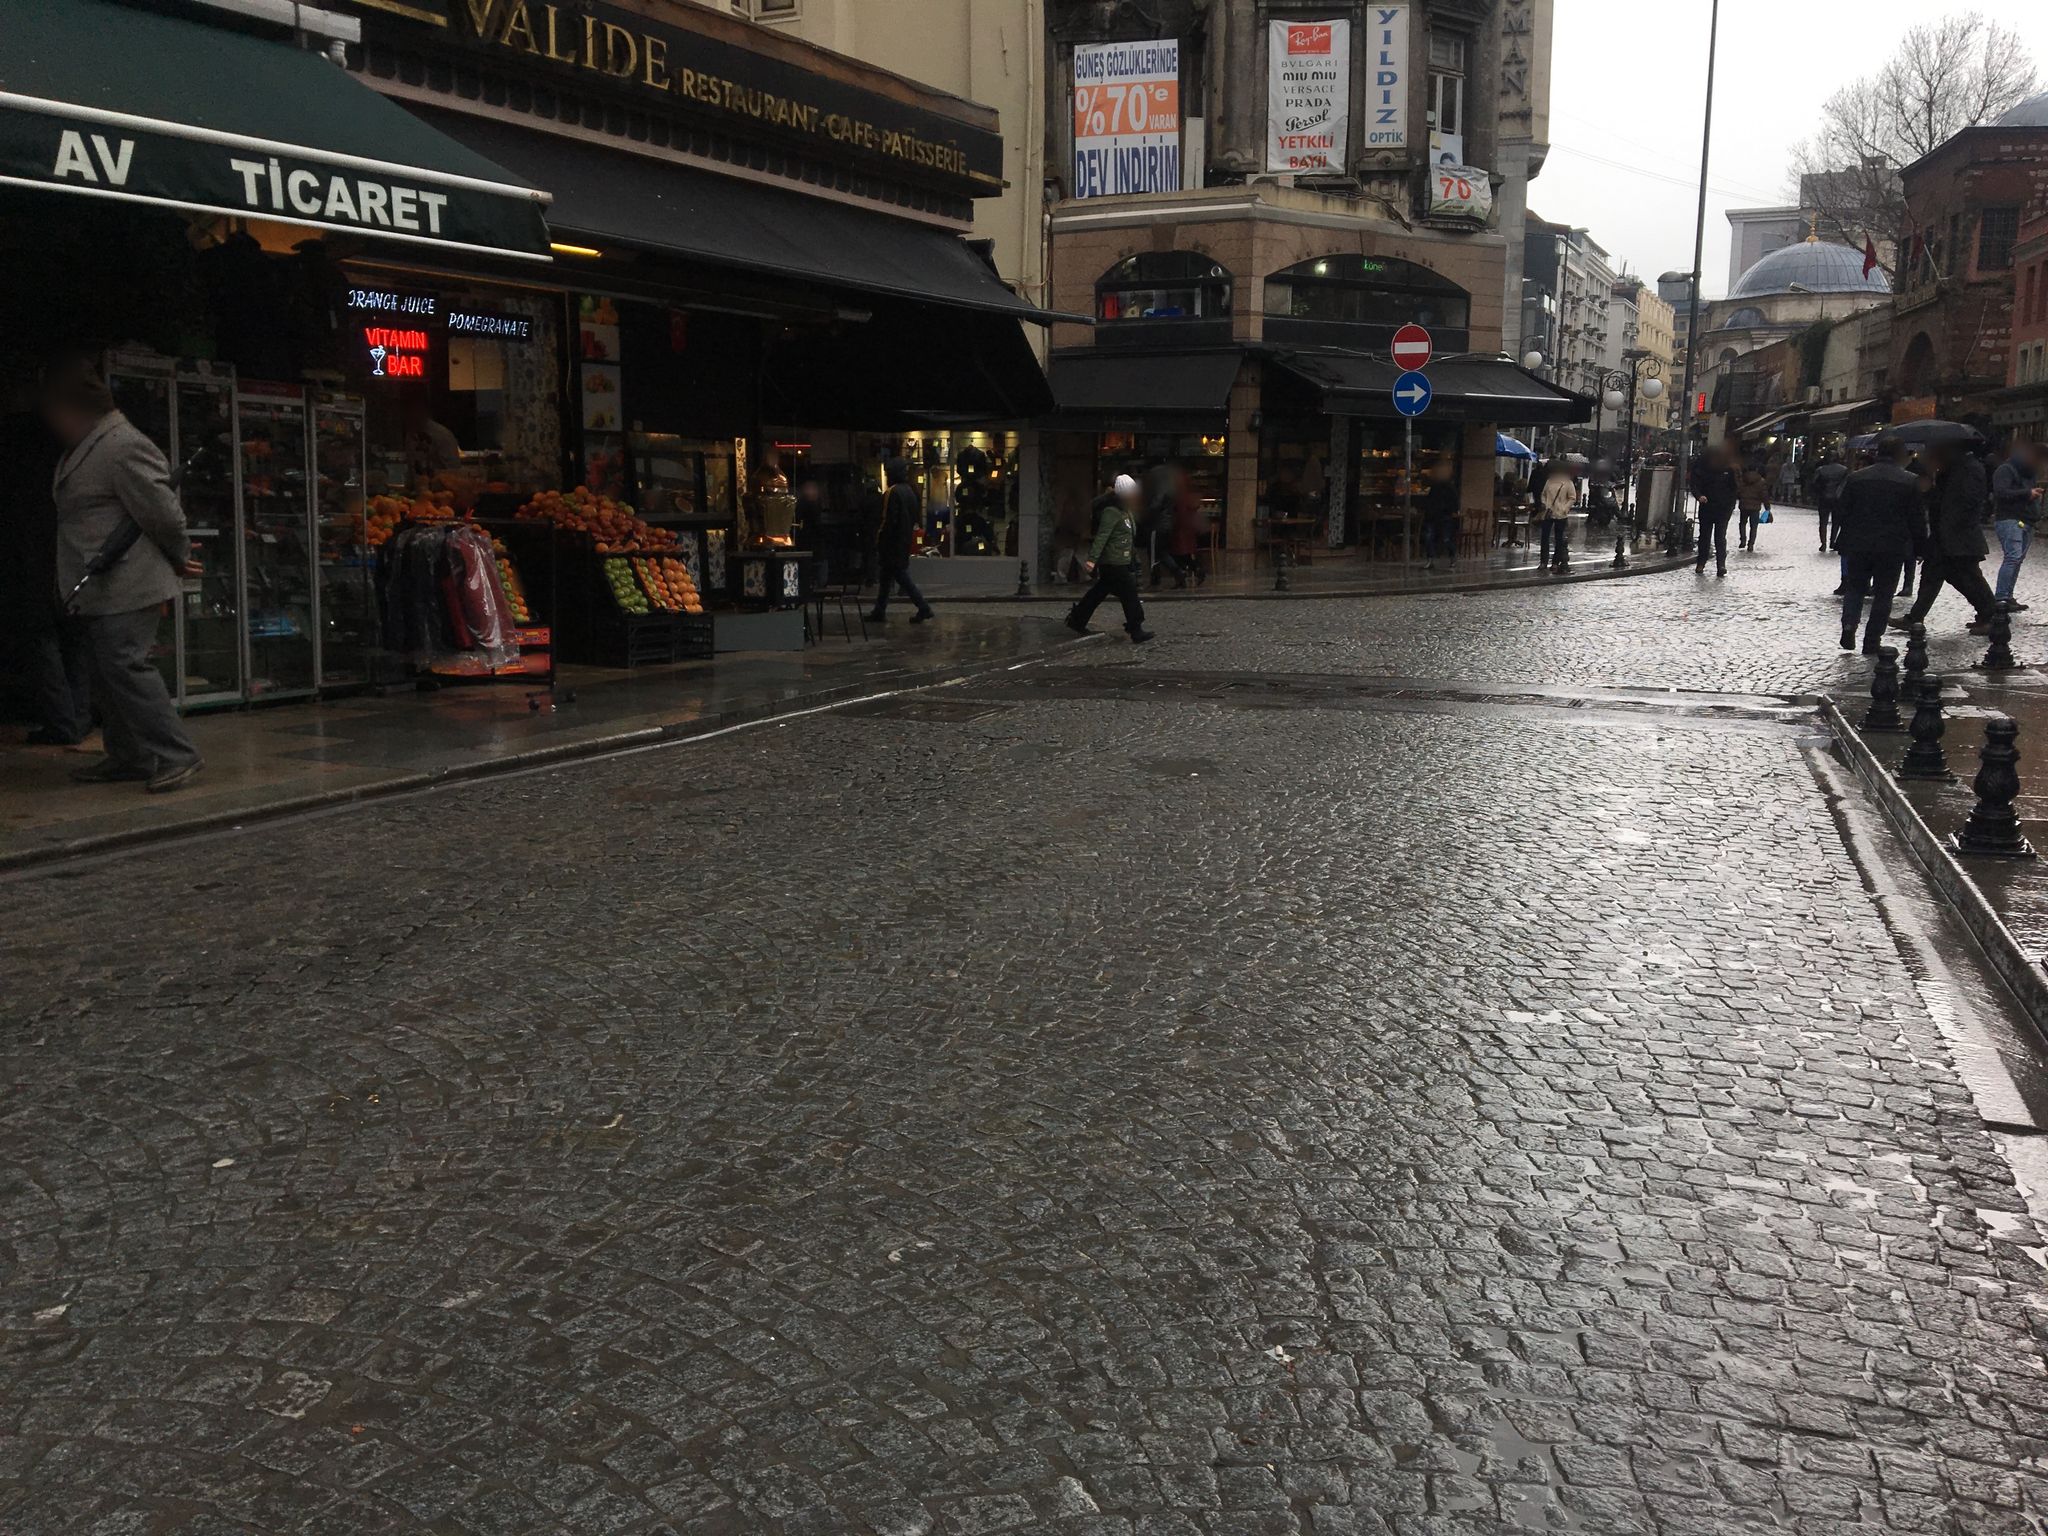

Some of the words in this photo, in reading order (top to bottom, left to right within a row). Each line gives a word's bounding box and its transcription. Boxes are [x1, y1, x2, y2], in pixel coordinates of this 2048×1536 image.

[1289, 26, 1329, 46] Ray-Ban
[1076, 48, 1105, 83] GÜNEŞ
[1106, 42, 1177, 76] GÖZLÜKLERİNDE
[1281, 60, 1338, 68] BVLGARI
[1376, 9, 1399, 124] YILDIZ
[1283, 84, 1336, 94] VERSACE
[1285, 97, 1332, 108] PRADA
[1149, 114, 1177, 130] VARAN
[1285, 108, 1331, 132] Persol
[1278, 131, 1335, 149] YETKİLİ
[1369, 128, 1403, 144] OPTİK
[1076, 149, 1109, 198] DEV
[1114, 135, 1177, 195] İNDİRİM
[53, 129, 134, 185] AV
[230, 157, 448, 233] TİCARET
[1439, 177, 1472, 200] 70
[401, 296, 435, 314] JUICE
[449, 312, 530, 337] POMEGRANATE
[388, 354, 424, 376] BAR
